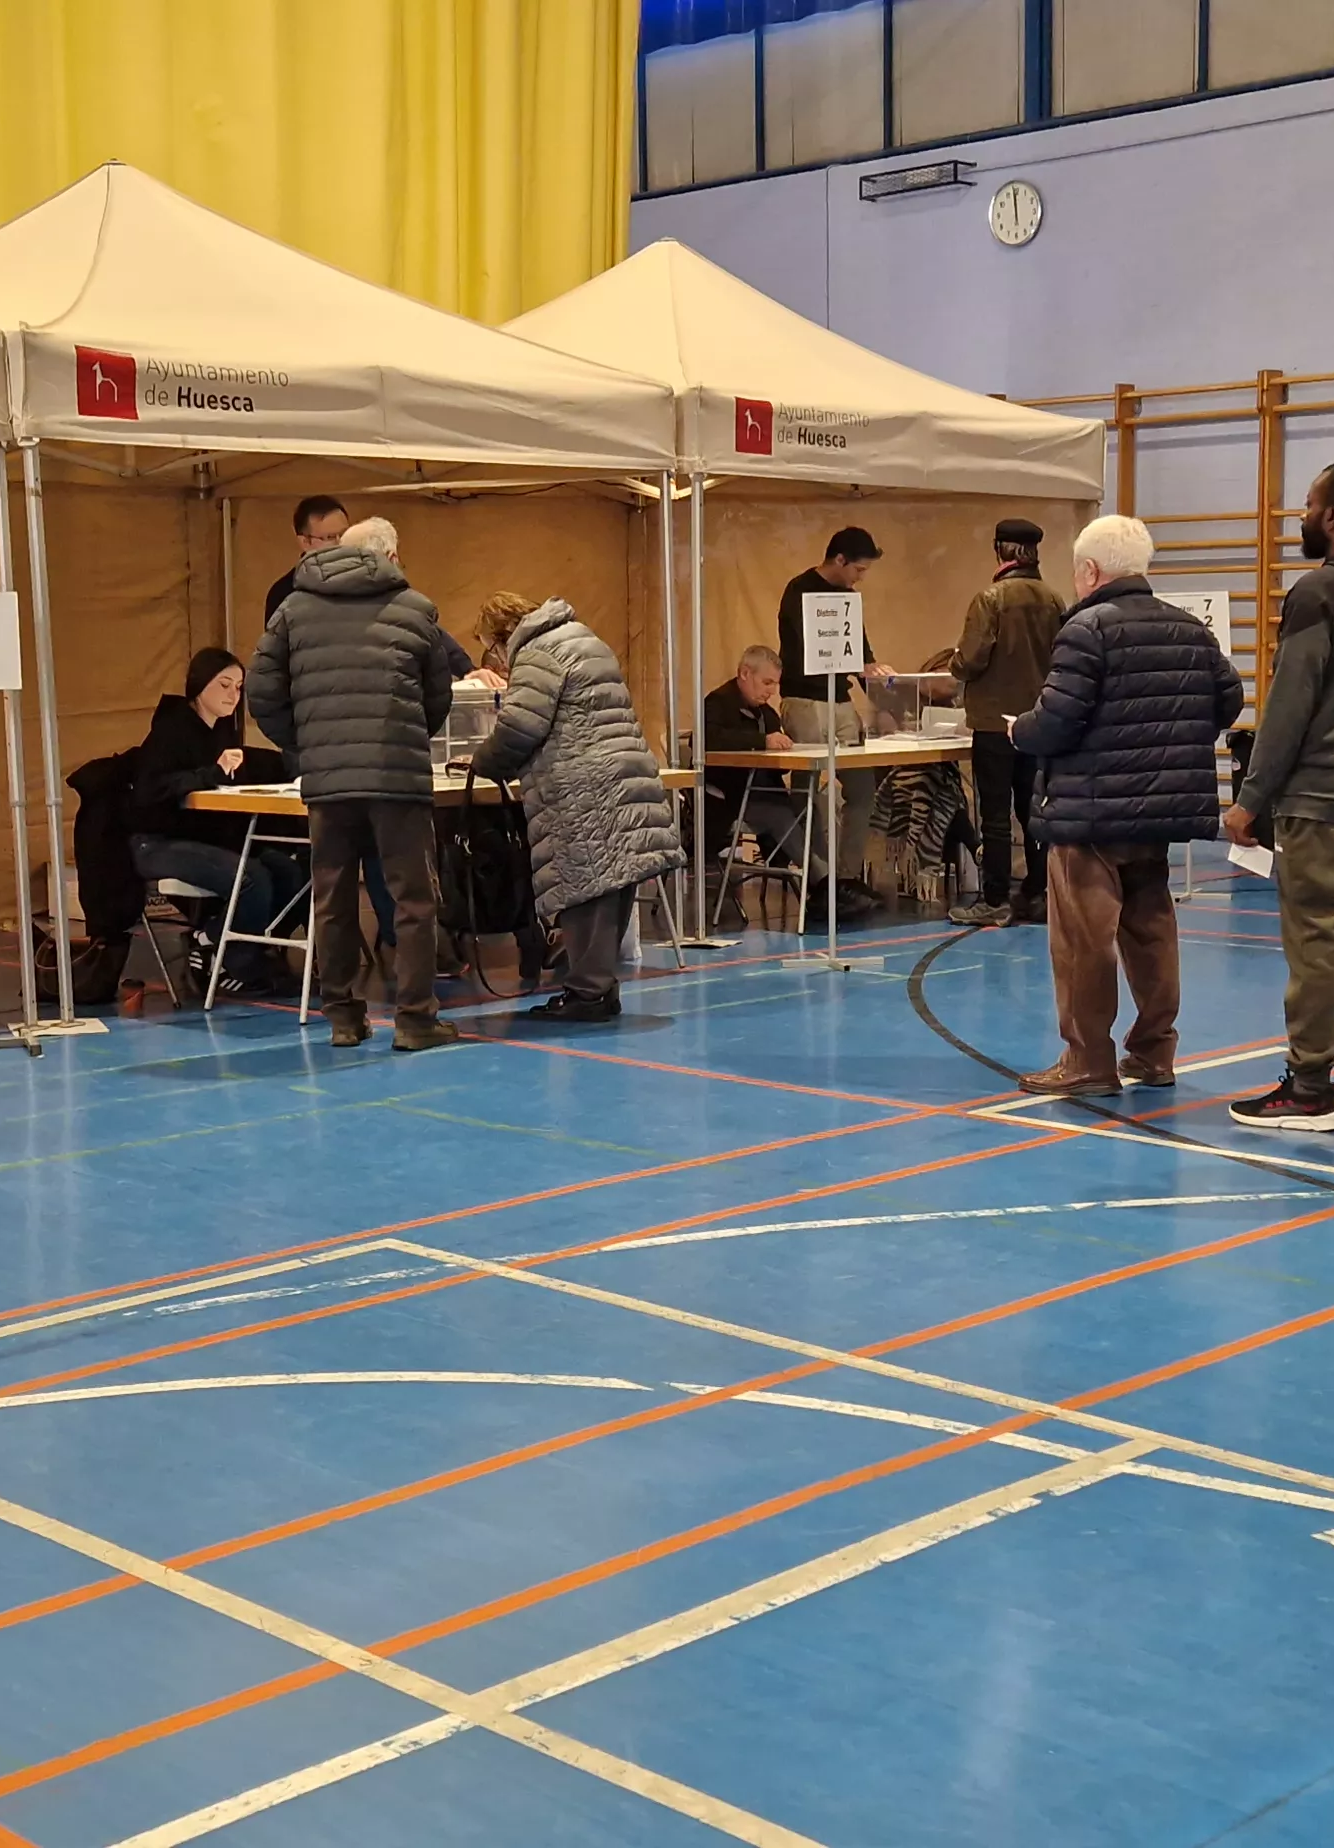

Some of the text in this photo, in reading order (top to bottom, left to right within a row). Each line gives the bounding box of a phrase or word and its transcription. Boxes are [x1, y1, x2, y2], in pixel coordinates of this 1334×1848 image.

[146, 356, 289, 387] Ayuntamiento
[145, 384, 254, 412] de Huesca
[777, 402, 870, 427] Ayuntamiento
[777, 426, 847, 448] de Huesca
[844, 602, 850, 617] 7
[1204, 599, 1212, 611] 7
[844, 621, 850, 636] 2
[1204, 615, 1213, 627] 2
[843, 641, 853, 656] A
